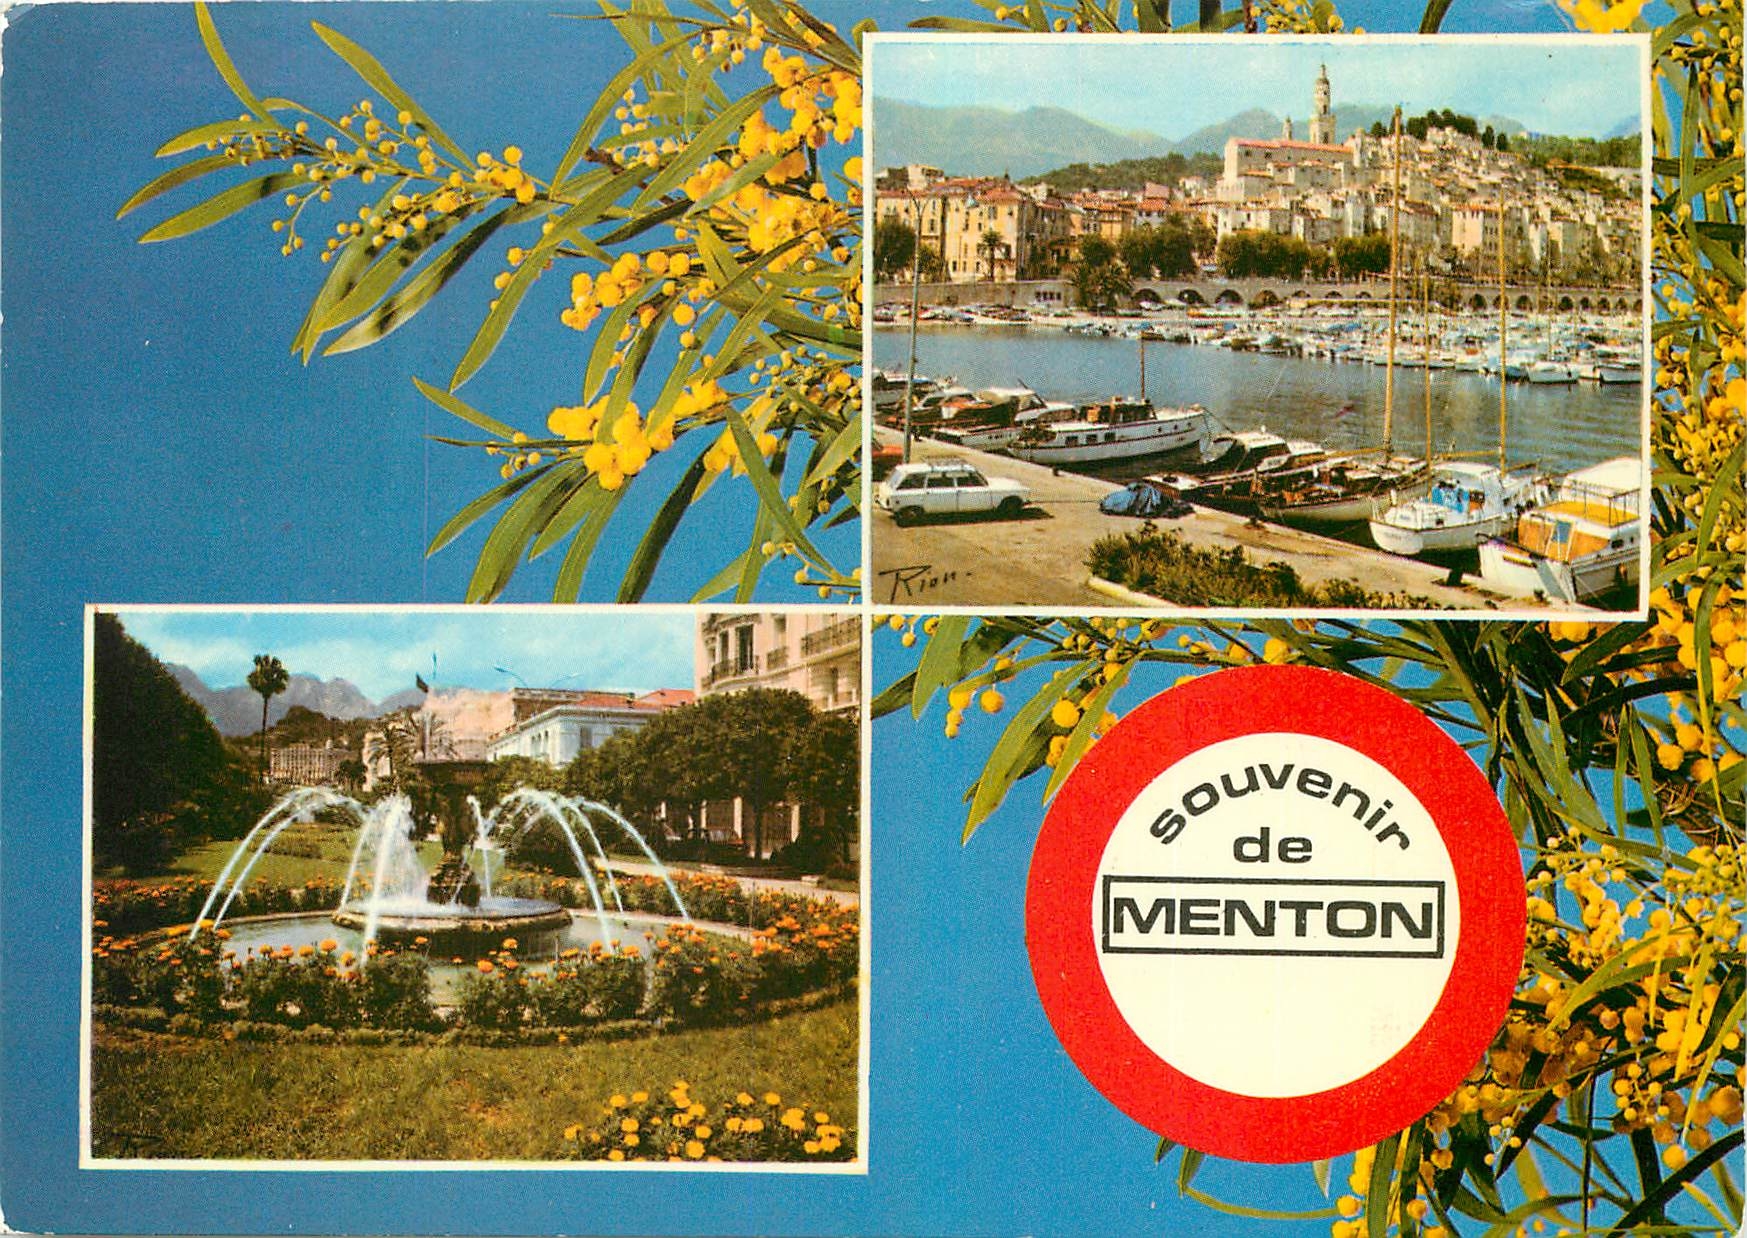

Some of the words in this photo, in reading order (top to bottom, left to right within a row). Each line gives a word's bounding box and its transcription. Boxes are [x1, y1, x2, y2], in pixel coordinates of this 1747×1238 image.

[1149, 763, 1411, 851] souvenir
[1232, 826, 1313, 864] de
[1112, 896, 1434, 940] MENTON
